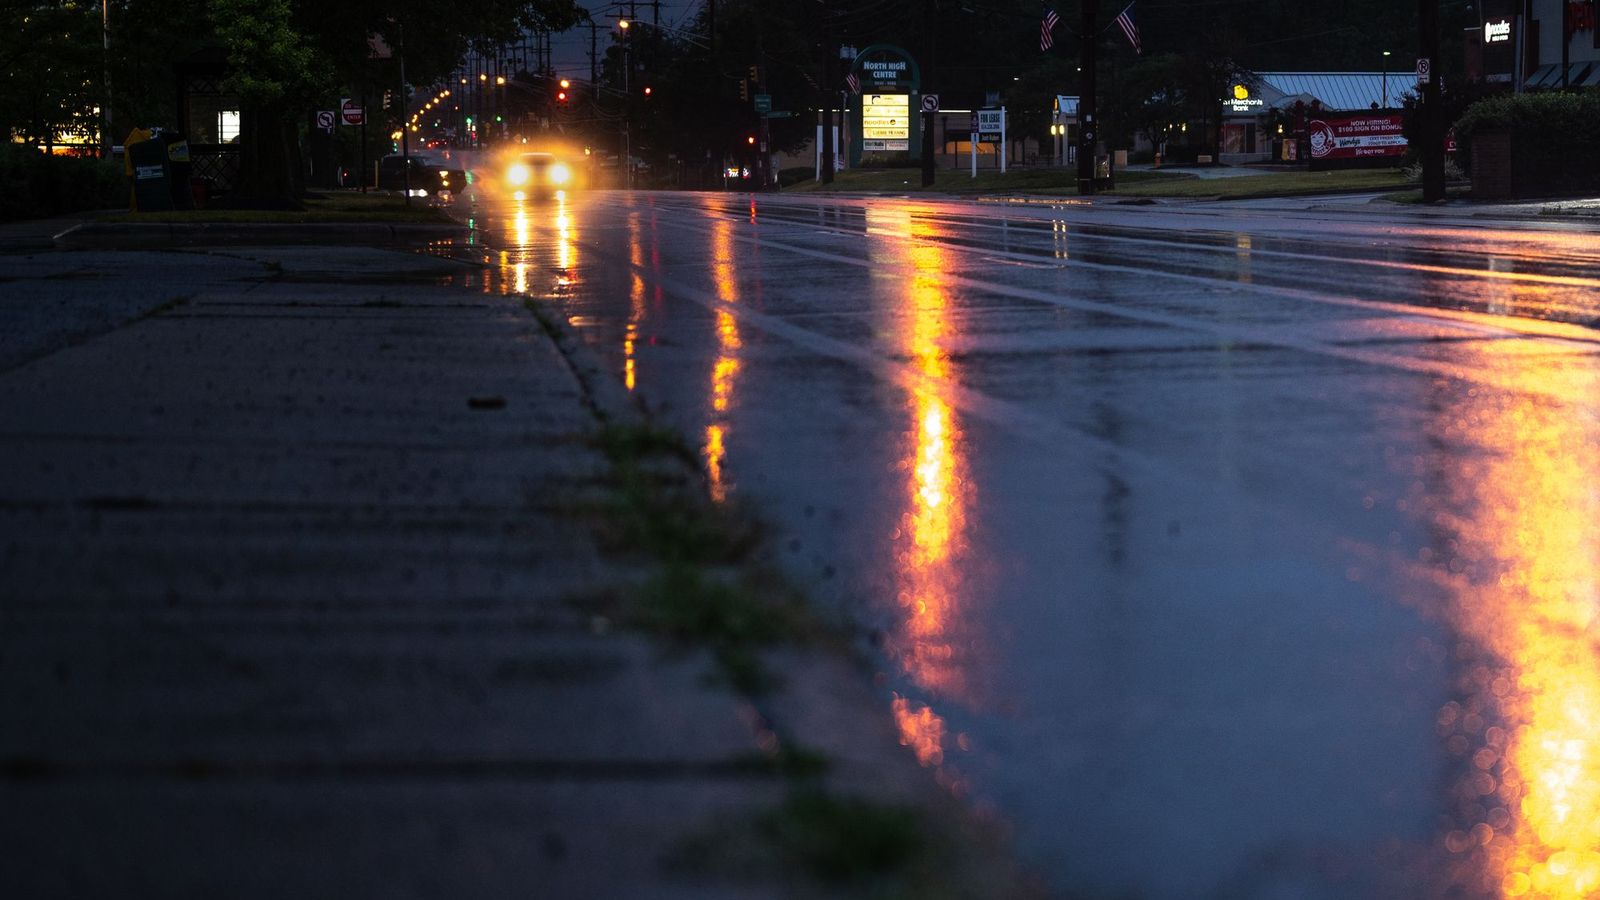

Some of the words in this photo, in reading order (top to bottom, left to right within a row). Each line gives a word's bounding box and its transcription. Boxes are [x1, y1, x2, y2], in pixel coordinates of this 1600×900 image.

[863, 61, 887, 70] NORTH
[888, 61, 906, 70] HIGH
[980, 114, 988, 123] FOR
[989, 113, 1000, 123] LEASE
